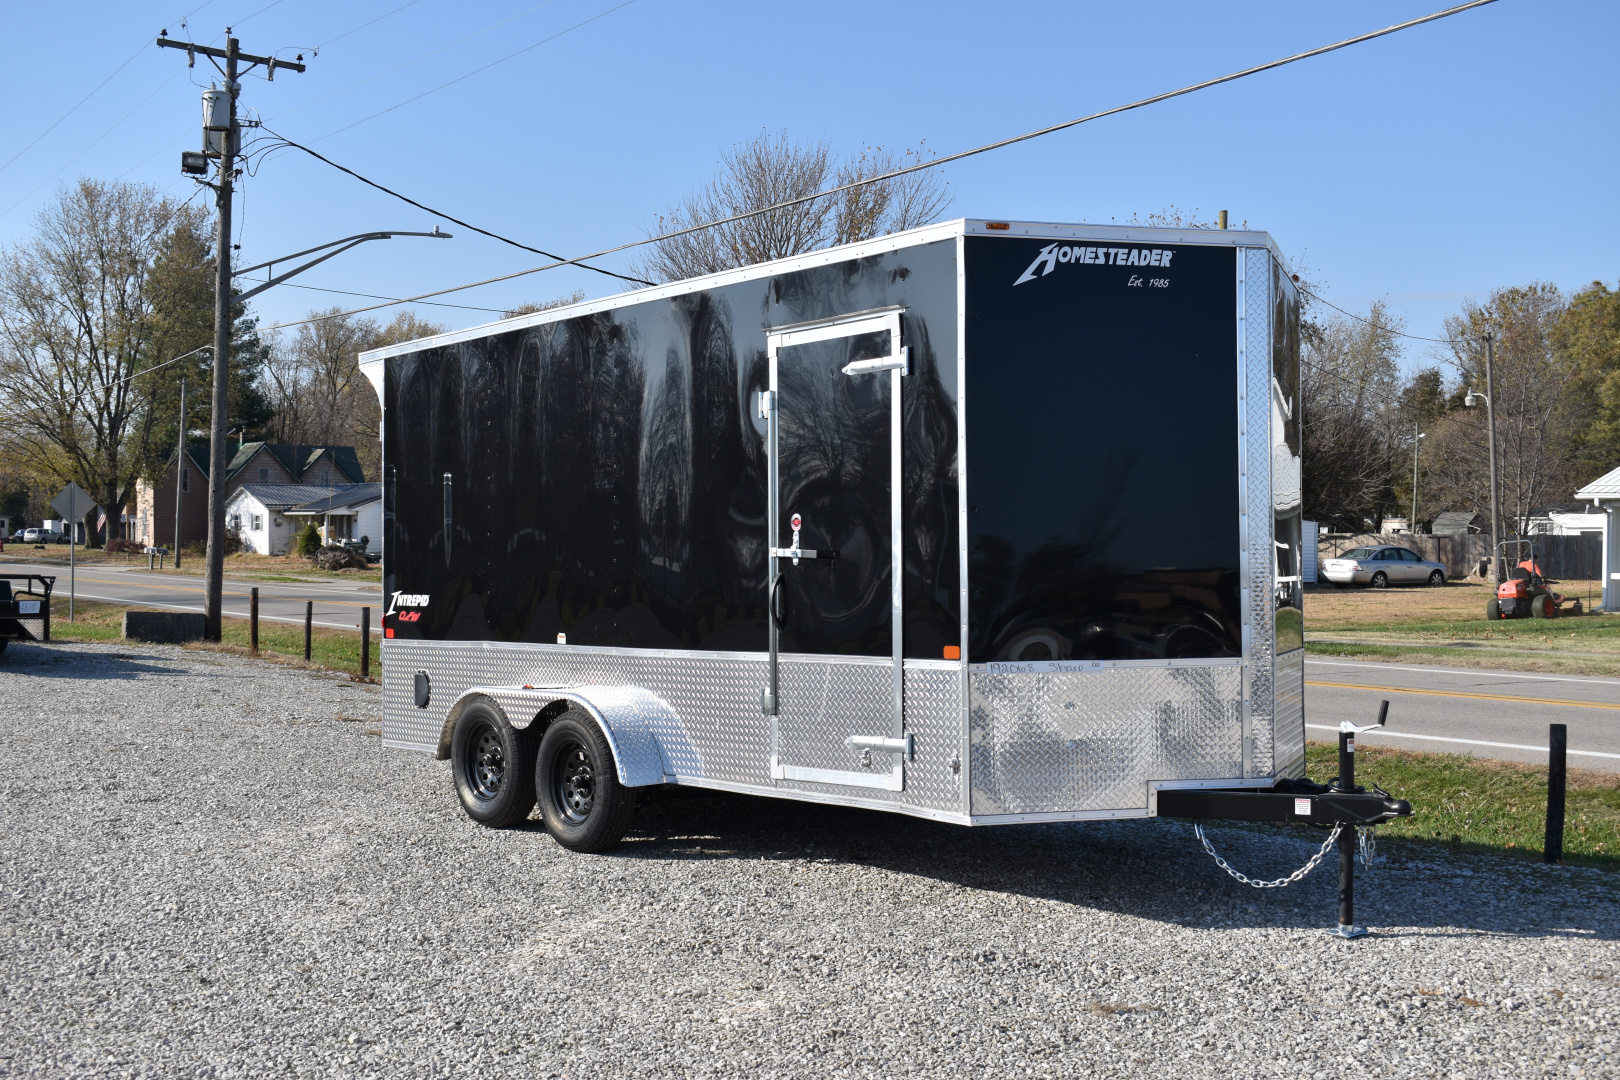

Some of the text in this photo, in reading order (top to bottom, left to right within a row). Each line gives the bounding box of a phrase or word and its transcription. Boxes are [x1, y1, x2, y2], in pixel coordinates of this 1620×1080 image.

[1012, 241, 1174, 287] HOMESTEADER
[1148, 278, 1170, 288] 1985
[385, 590, 430, 617] INTREPID
[1048, 662, 1084, 673] Sharp
